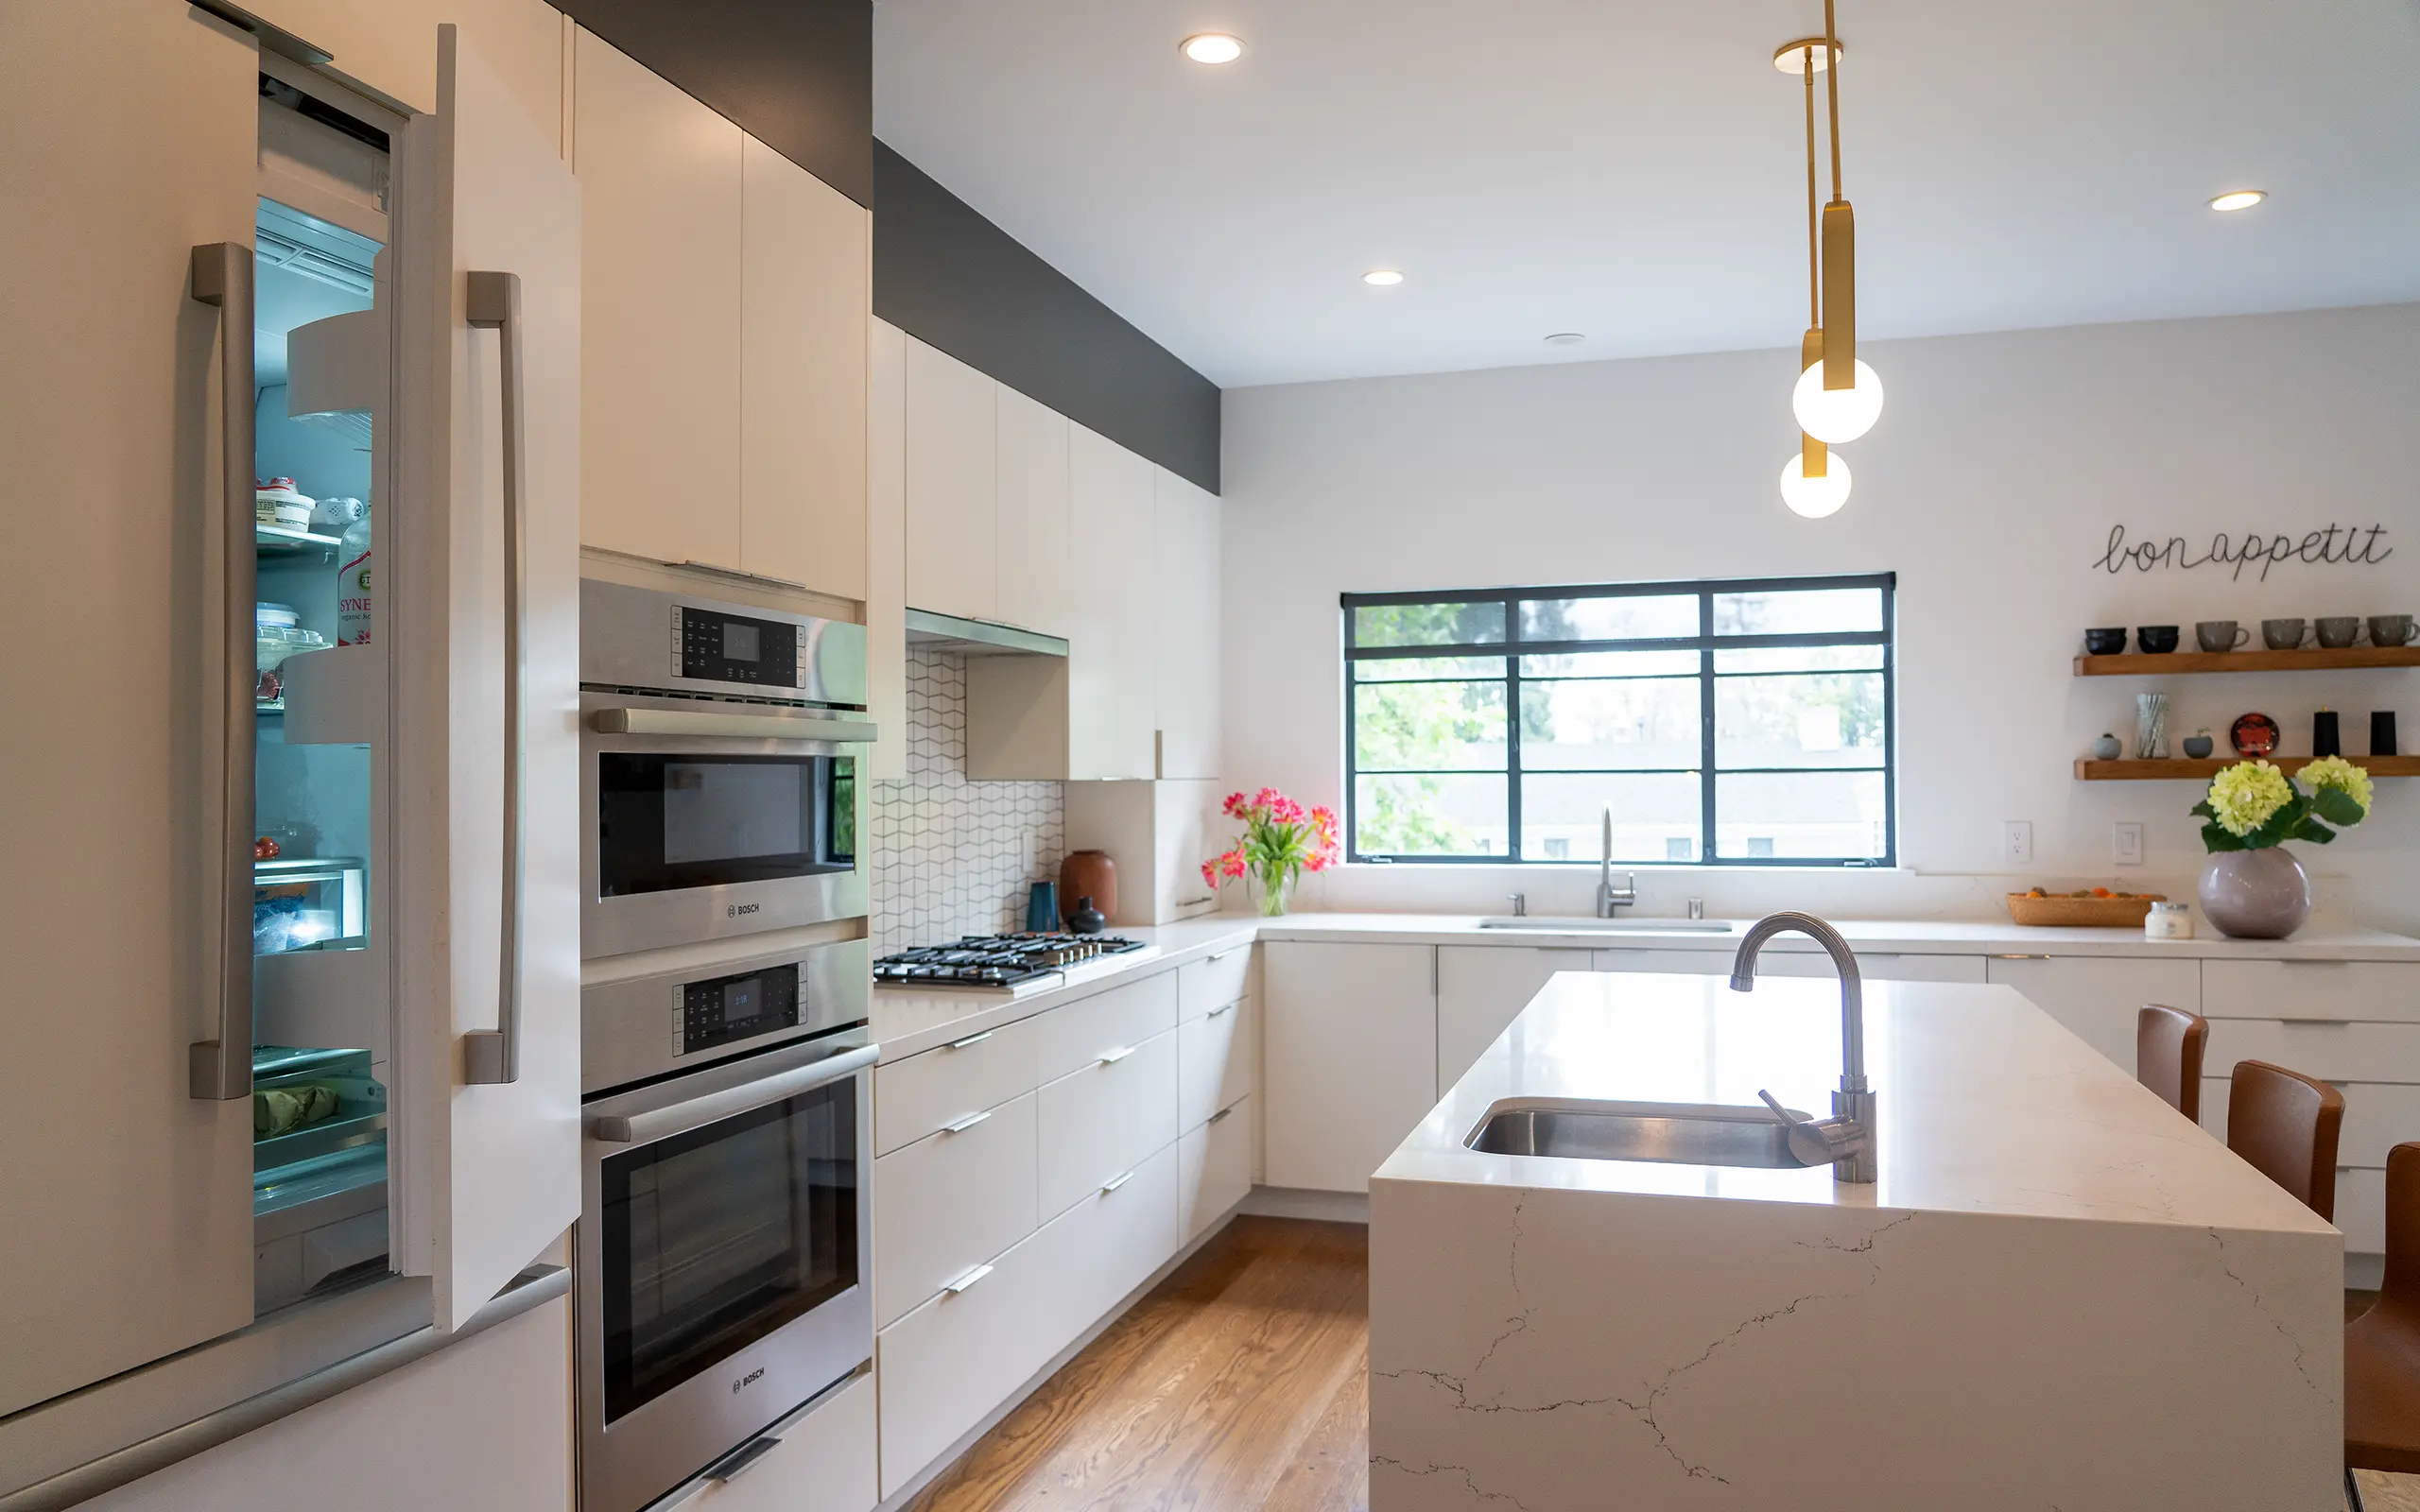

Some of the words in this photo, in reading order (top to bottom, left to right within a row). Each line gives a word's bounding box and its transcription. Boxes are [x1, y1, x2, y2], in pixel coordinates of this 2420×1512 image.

[2092, 524, 2193, 574] bon
[2209, 523, 2394, 582] appetit
[737, 903, 759, 915] BOSCH
[743, 1366, 765, 1386] BOSCH
